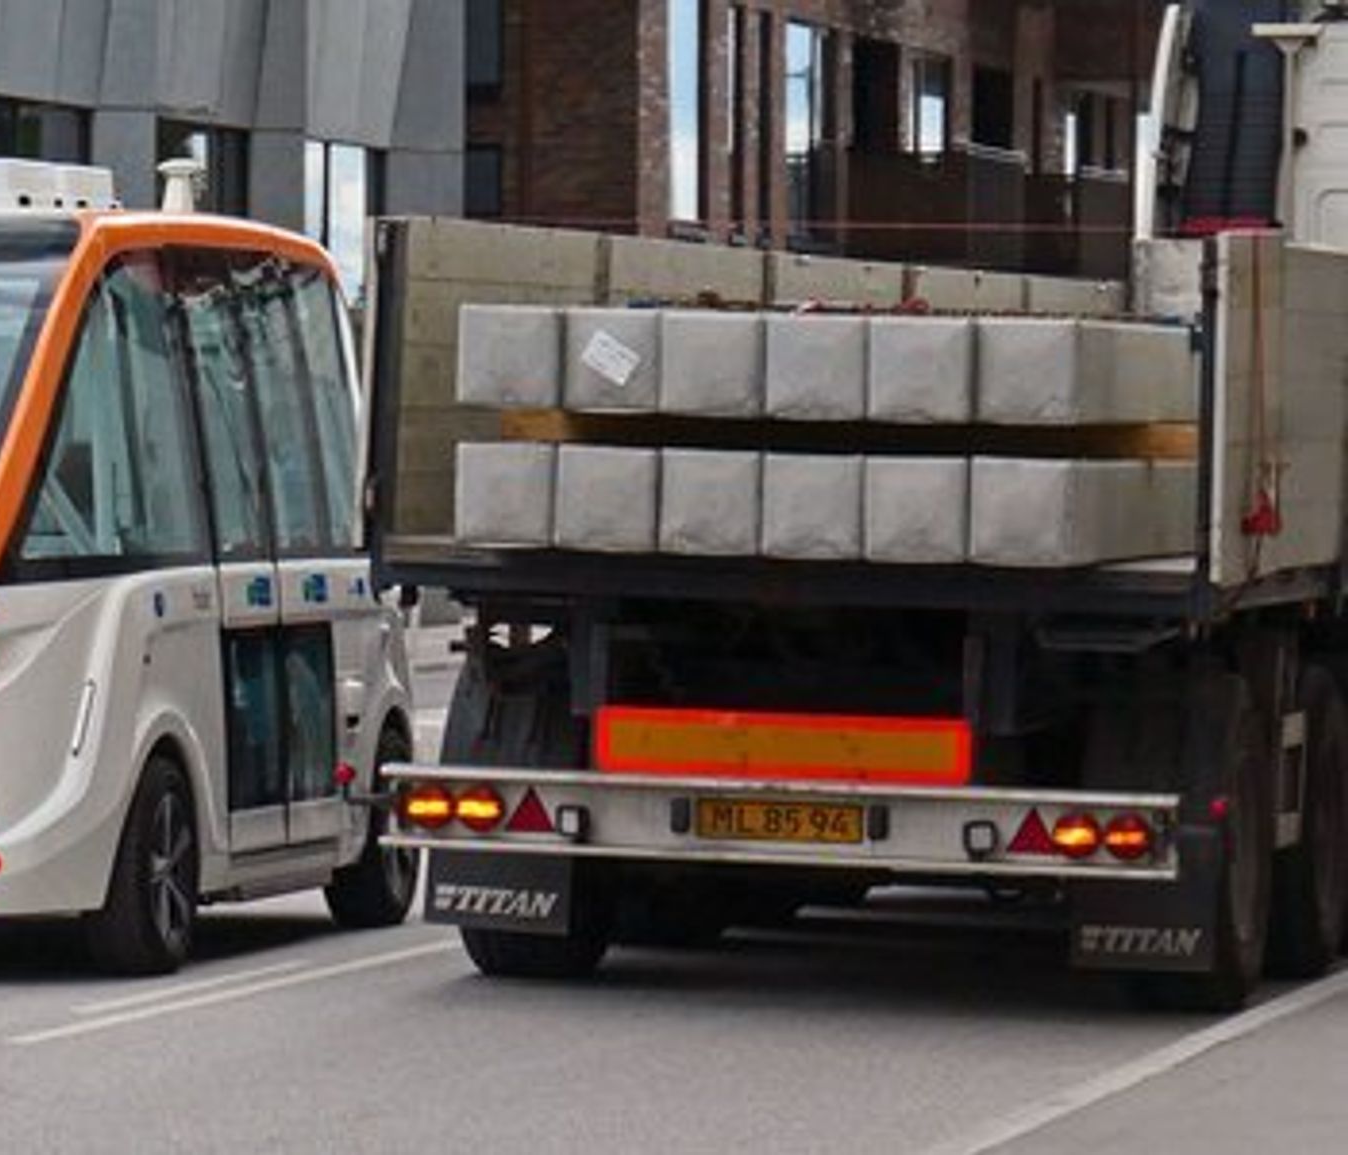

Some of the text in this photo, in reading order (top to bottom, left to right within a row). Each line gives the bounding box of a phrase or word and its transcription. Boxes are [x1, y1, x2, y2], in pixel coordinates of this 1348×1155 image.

[712, 804, 848, 836] ML 85 94
[453, 885, 559, 918] TITAN
[1103, 925, 1203, 957] TITAN
